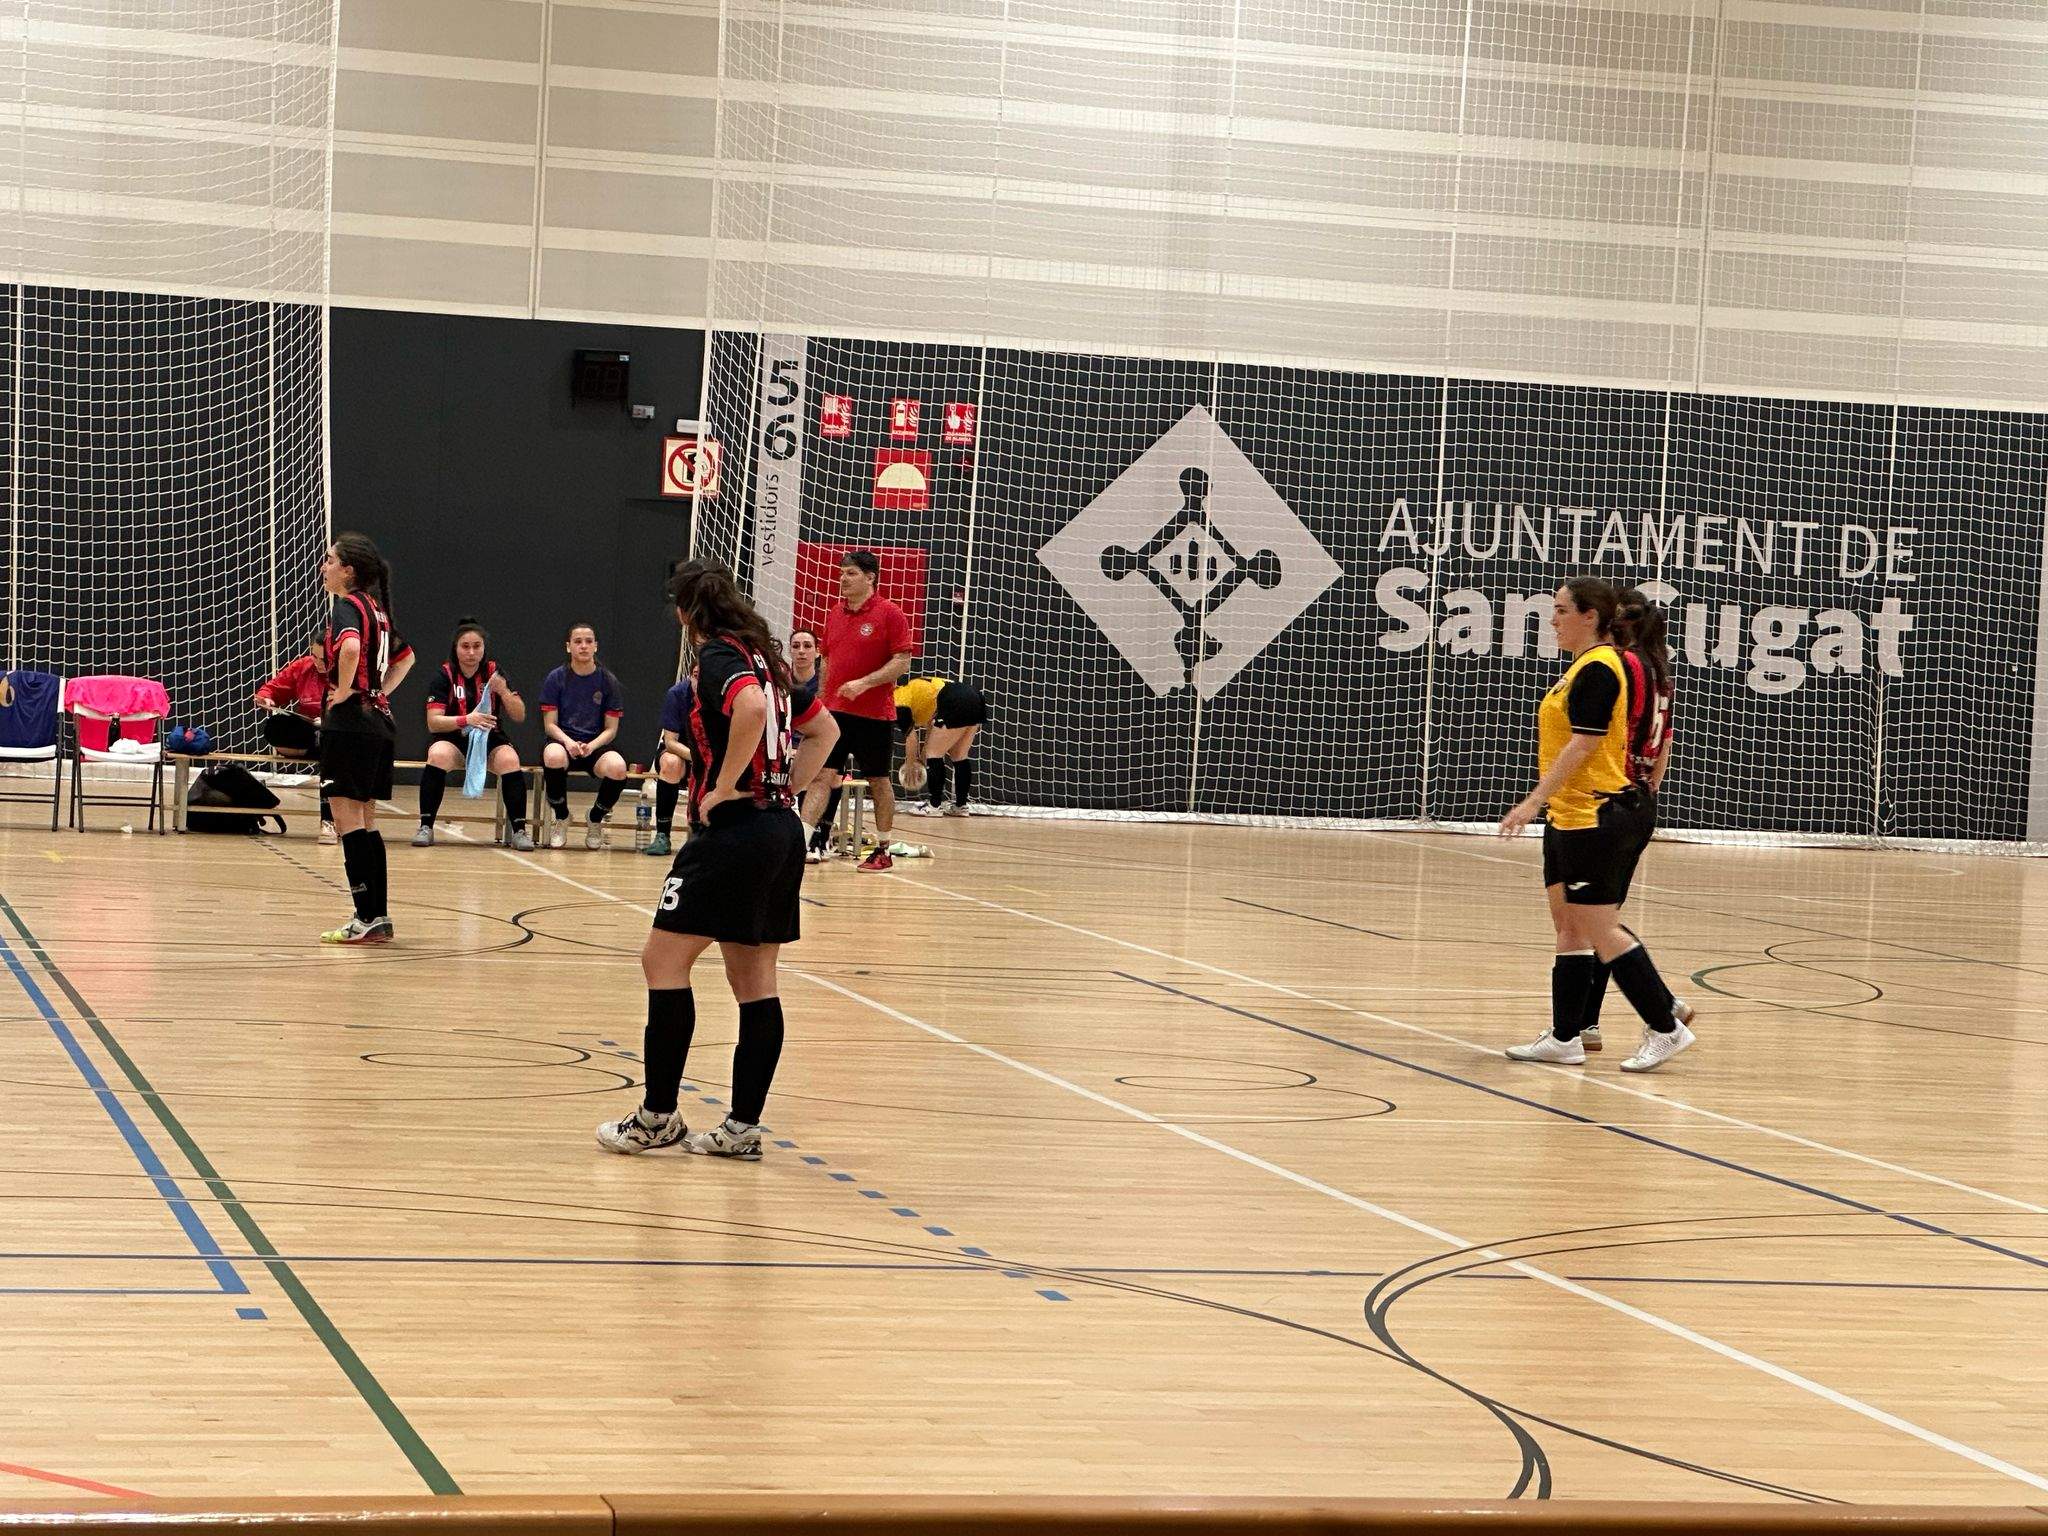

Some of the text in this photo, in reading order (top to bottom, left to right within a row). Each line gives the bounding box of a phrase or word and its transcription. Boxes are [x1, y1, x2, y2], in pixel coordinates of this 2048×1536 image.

[767, 359, 799, 407] 5
[763, 414, 797, 461] 6
[758, 473, 780, 566] vestidors
[1377, 498, 1918, 582] AJUNTAMENT DE
[1375, 567, 1914, 695] San ugat
[659, 877, 684, 910] 13
